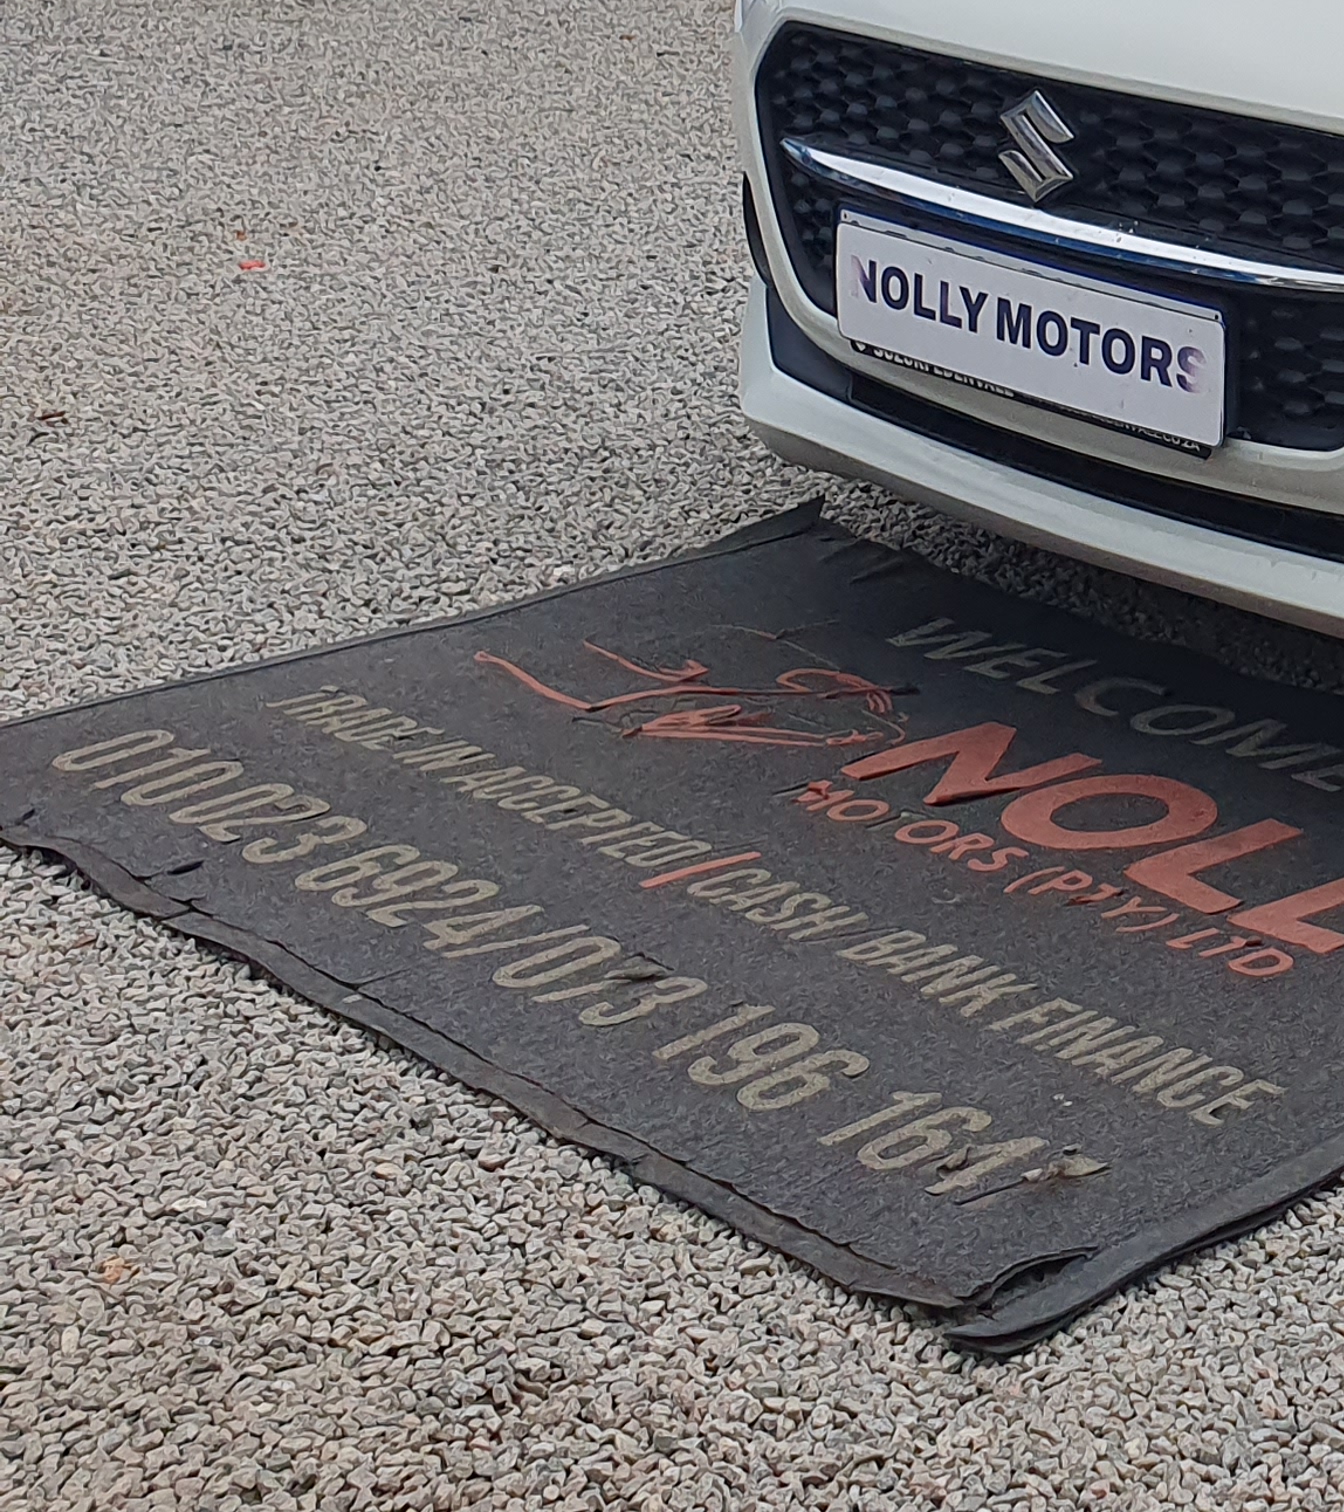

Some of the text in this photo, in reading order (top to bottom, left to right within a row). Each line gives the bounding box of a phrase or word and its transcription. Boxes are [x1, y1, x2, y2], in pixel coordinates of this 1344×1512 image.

[851, 254, 1210, 394] NOLLY MOTORS
[265, 685, 445, 750] TRADE
[392, 740, 496, 772] IN
[986, 997, 1286, 1126] FINANCE
[1165, 927, 1294, 977] LTD
[651, 1001, 870, 1112] 196
